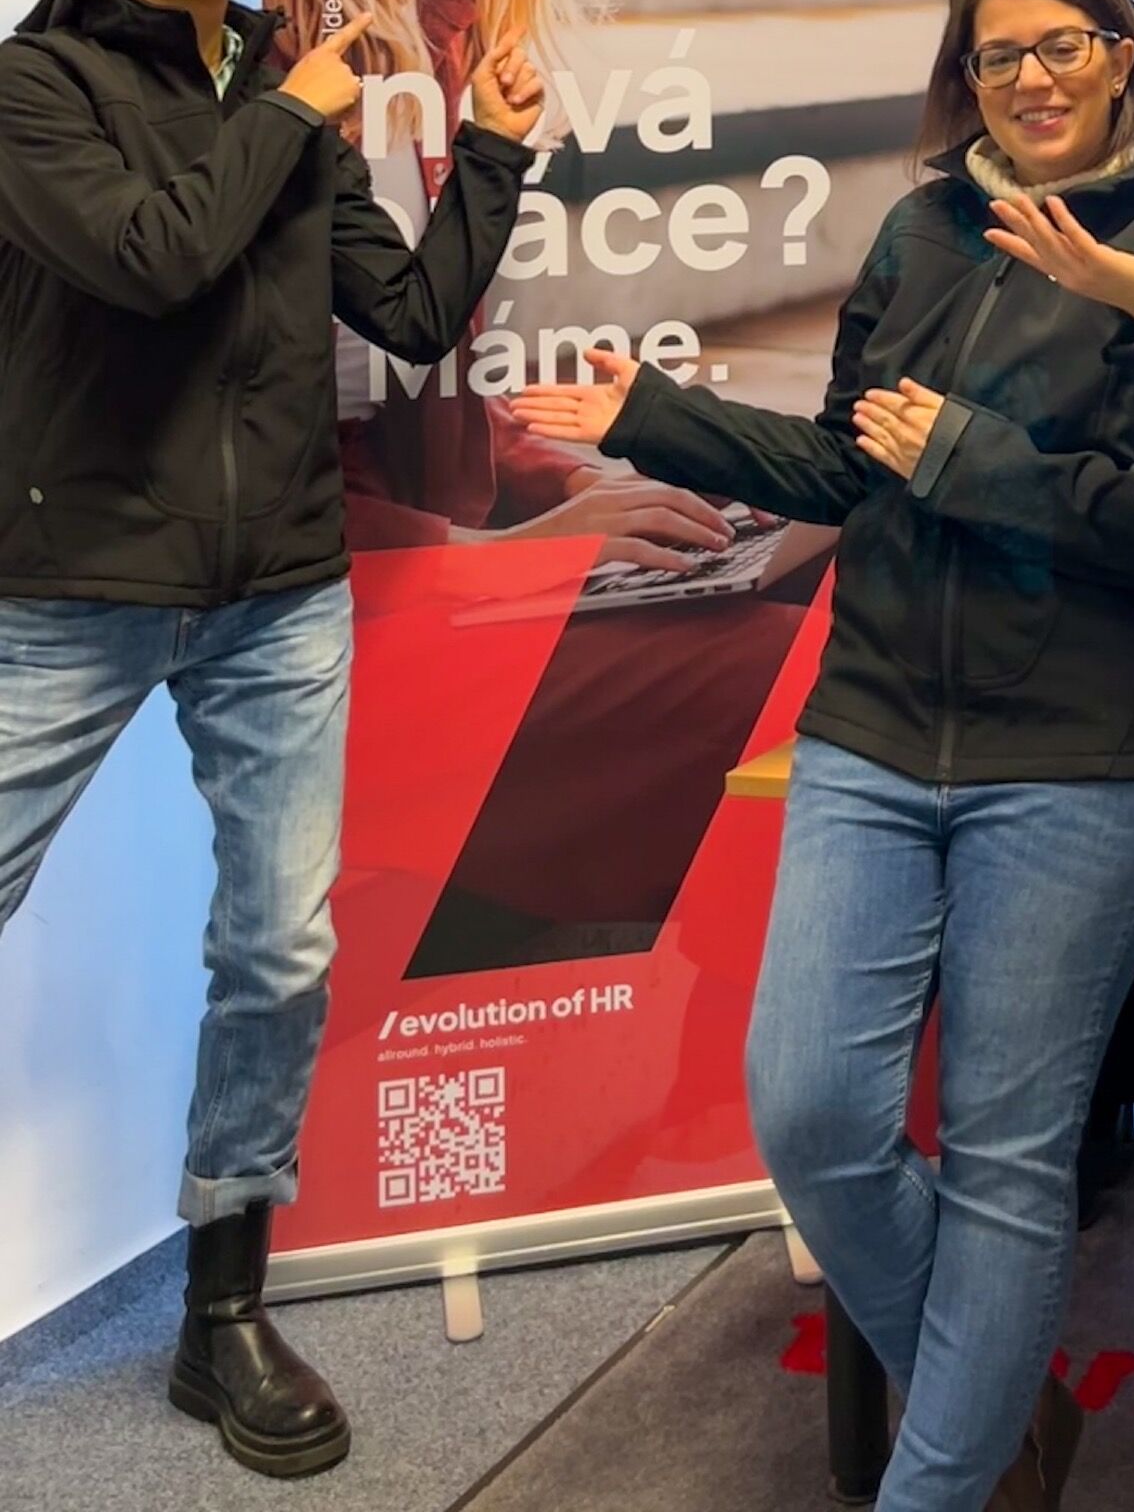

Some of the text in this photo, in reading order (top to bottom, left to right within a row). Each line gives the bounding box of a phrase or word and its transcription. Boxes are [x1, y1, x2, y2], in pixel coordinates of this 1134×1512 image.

[361, 29, 713, 159] nvá
[373, 152, 832, 280] áce?
[551, 989, 585, 1017] of
[590, 984, 634, 1013] HR
